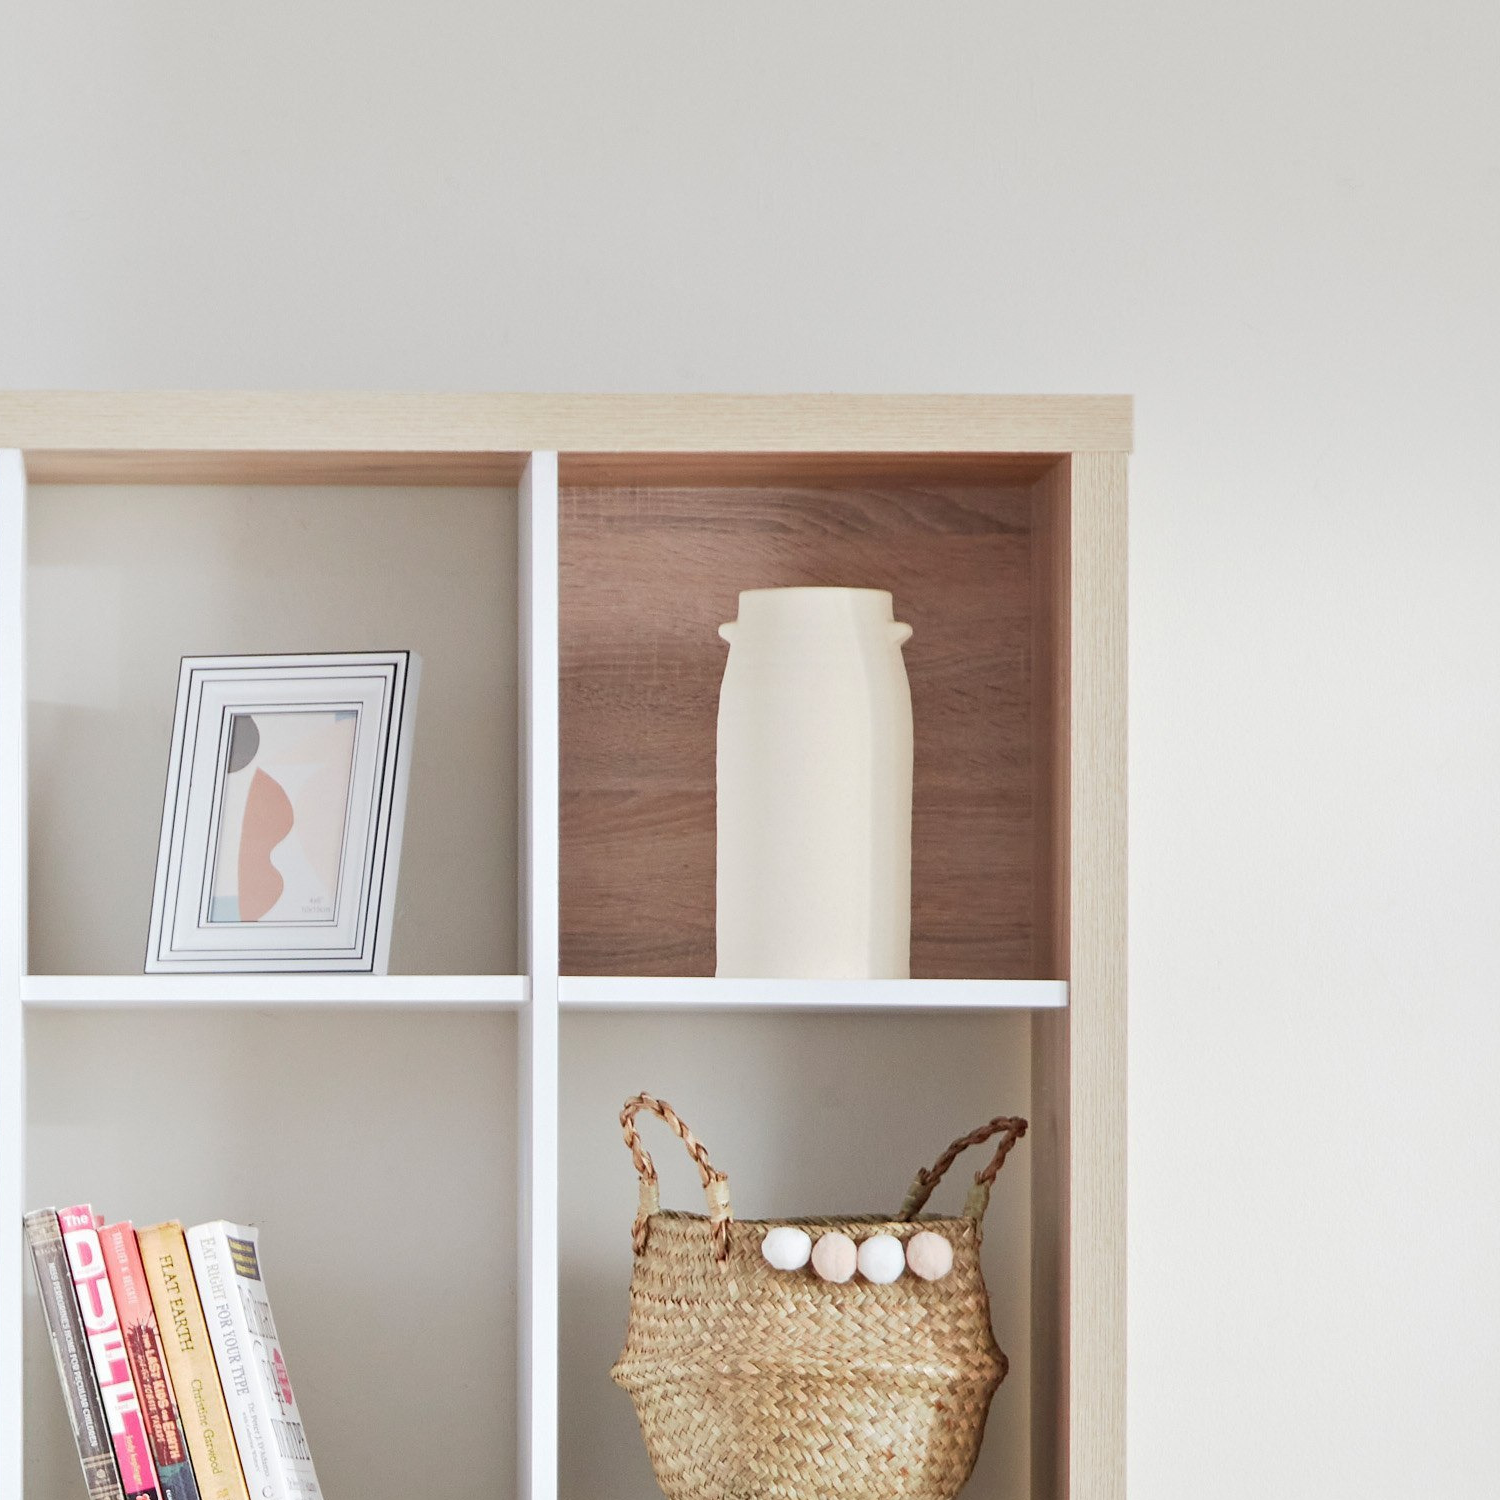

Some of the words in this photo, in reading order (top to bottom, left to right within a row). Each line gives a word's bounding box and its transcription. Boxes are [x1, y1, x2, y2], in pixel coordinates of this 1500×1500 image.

[63, 1214, 88, 1227] The
[206, 1262, 226, 1302] RIGHT
[159, 1253, 179, 1295] FLAT
[169, 1297, 193, 1352] EARTH
[216, 1303, 233, 1330] FOR
[223, 1330, 241, 1363] YOUR
[231, 1364, 249, 1395] TYPE
[68, 1353, 80, 1371] FOR
[81, 1408, 97, 1447] CHILDREN
[144, 1348, 162, 1380] LAST
[161, 1420, 181, 1459] EARTH
[190, 1377, 210, 1426] Christine
[203, 1428, 222, 1475] Garwood
